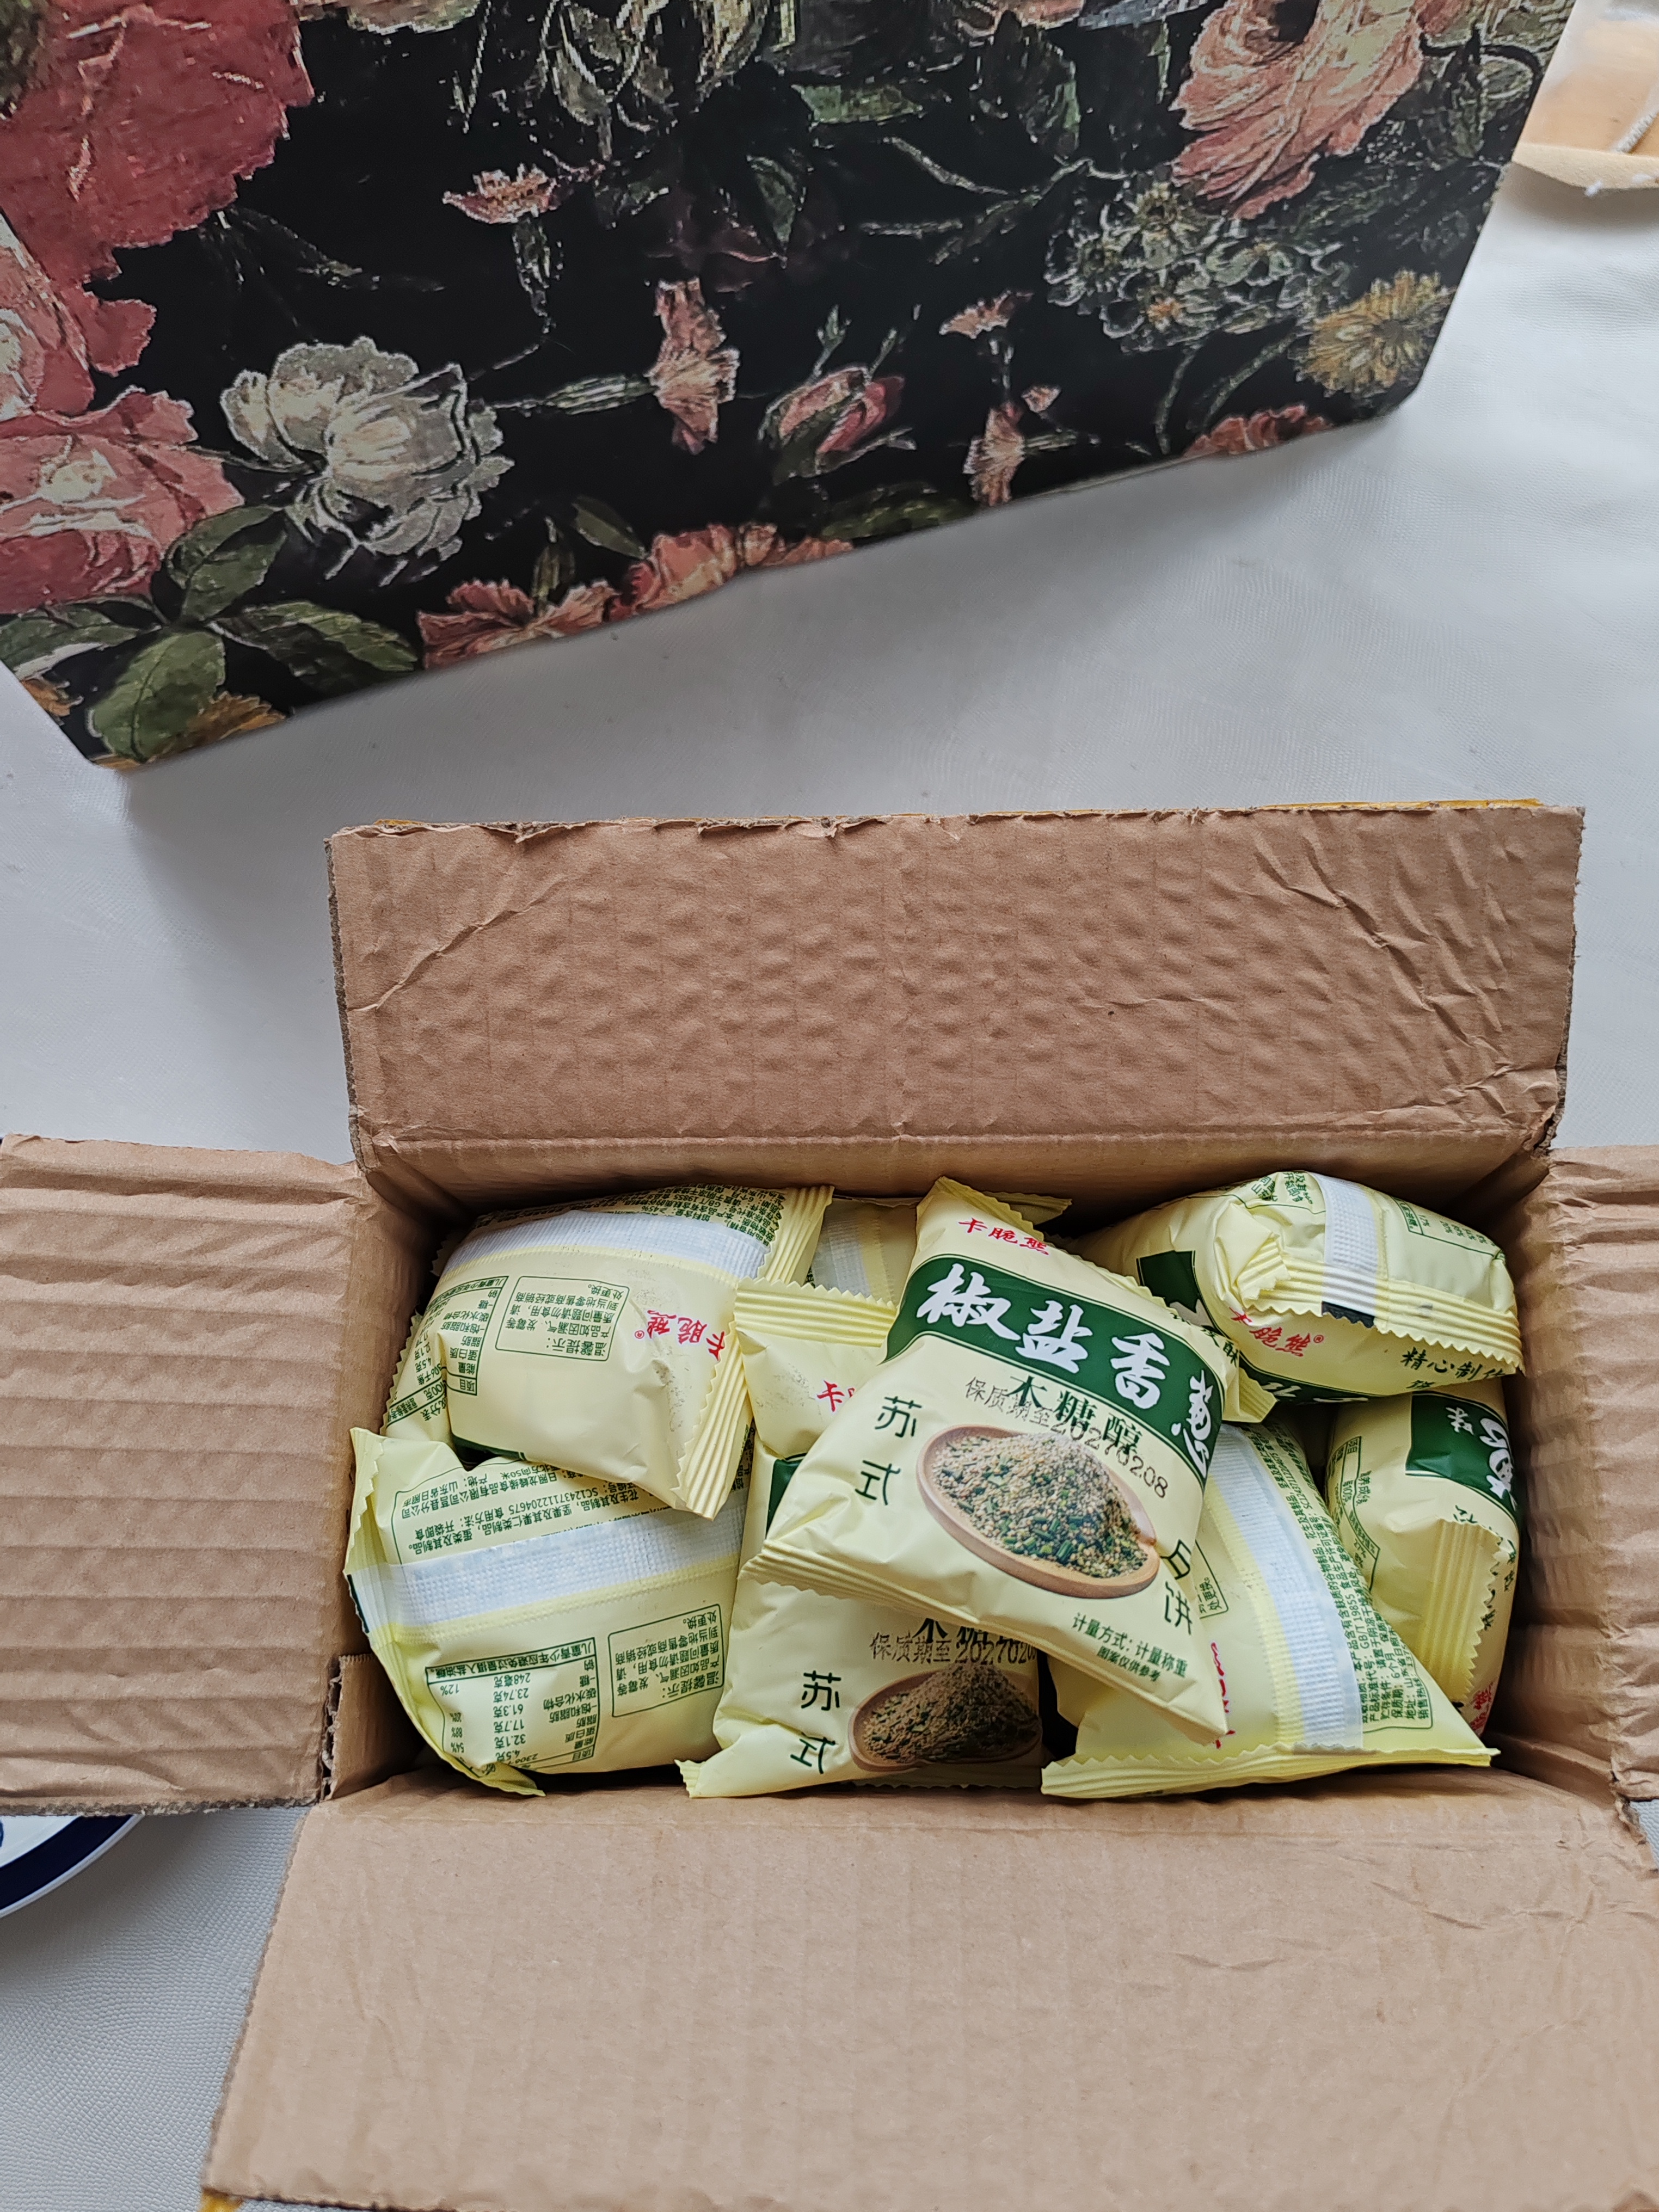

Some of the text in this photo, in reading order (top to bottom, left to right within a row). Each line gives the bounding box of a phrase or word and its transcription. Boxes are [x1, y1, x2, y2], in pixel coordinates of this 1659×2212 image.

[673, 1194, 698, 1202] 19855
[956, 1214, 1053, 1257] 卡脆熊
[487, 1288, 498, 1299] 钠
[514, 1290, 619, 1310] 到当地零售商或经销商
[586, 1283, 624, 1298] 处更换。
[460, 1334, 482, 1348] 脂肪
[544, 1337, 606, 1356] 温馨提示：
[448, 1346, 478, 1359] 蛋白质
[456, 1361, 476, 1374] 能量
[916, 1264, 1213, 1479] 椒盐香葱
[457, 1378, 475, 1391] 项目
[401, 1472, 488, 1507] 产地：山东省日照市
[413, 1506, 503, 1541] 食用方法：开袋即食
[1199, 1576, 1222, 1611] 处更换。
[1350, 1594, 1361, 1620] 19855
[681, 1609, 717, 1630] 处更换。
[613, 1625, 718, 1666] 到当地零售商或经销商
[1070, 1611, 1190, 1678] 计量方式：计量称重
[439, 1658, 594, 1696] 钠 248毫克 12%
[615, 1654, 720, 1697] 产品如因漏气、发霉等
[660, 1669, 720, 1698] 温馨提示：
[491, 1687, 530, 1704] 23.74克
[542, 1687, 597, 1710] 碳水化合物
[491, 1702, 524, 1718] 61.3克
[450, 1713, 598, 1753] 脂肪 32.1克 54%
[491, 1717, 525, 1734] 17.7克
[495, 1725, 595, 1762] 蛋白质 4.5克
[573, 1736, 594, 1749] 能量
[572, 1749, 592, 1761] 项目
